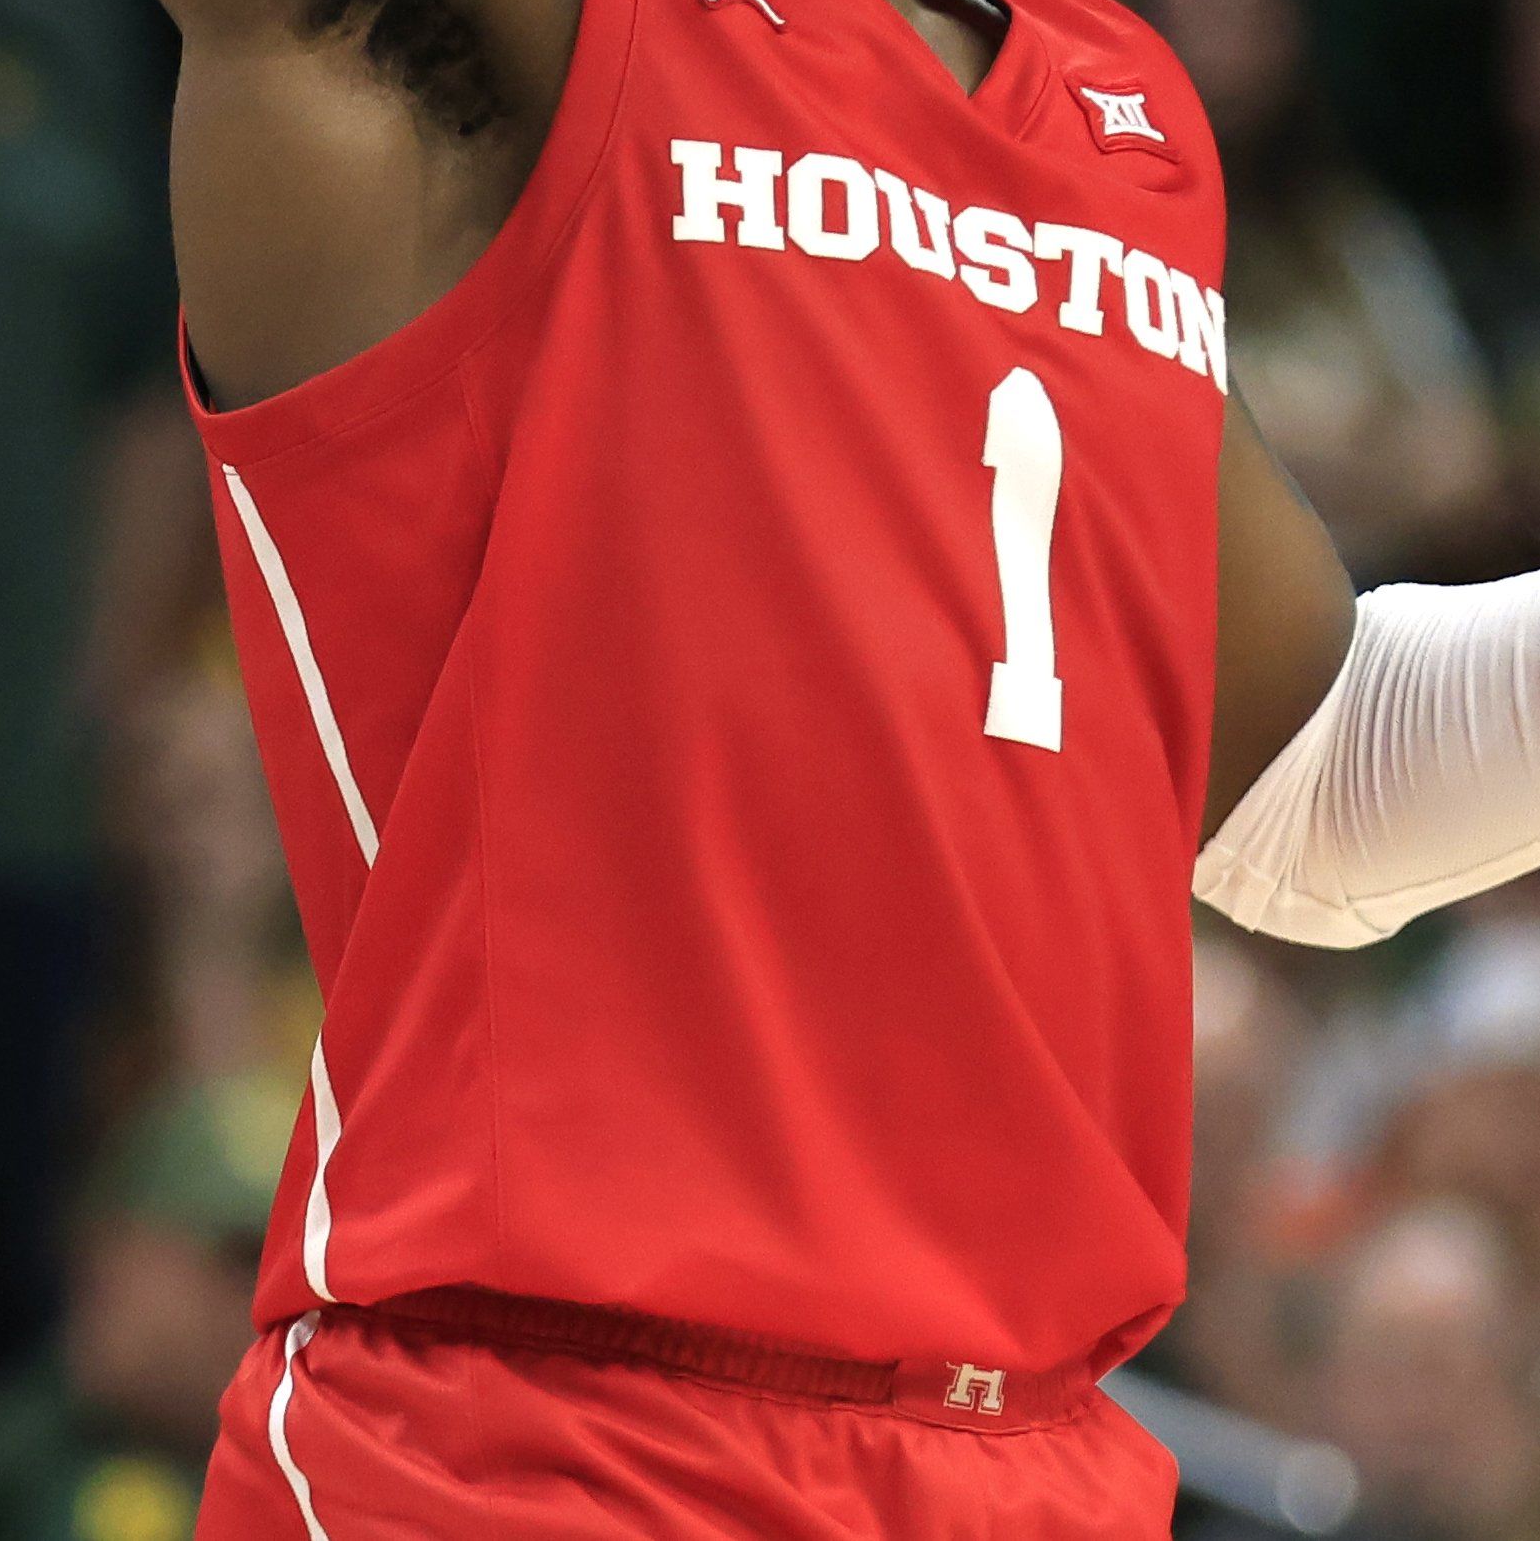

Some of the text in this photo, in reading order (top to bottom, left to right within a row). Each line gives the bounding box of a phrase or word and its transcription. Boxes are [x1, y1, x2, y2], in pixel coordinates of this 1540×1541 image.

[1080, 86, 1165, 142] XII
[671, 139, 1228, 395] HOUSTON
[982, 366, 1063, 752] 1
